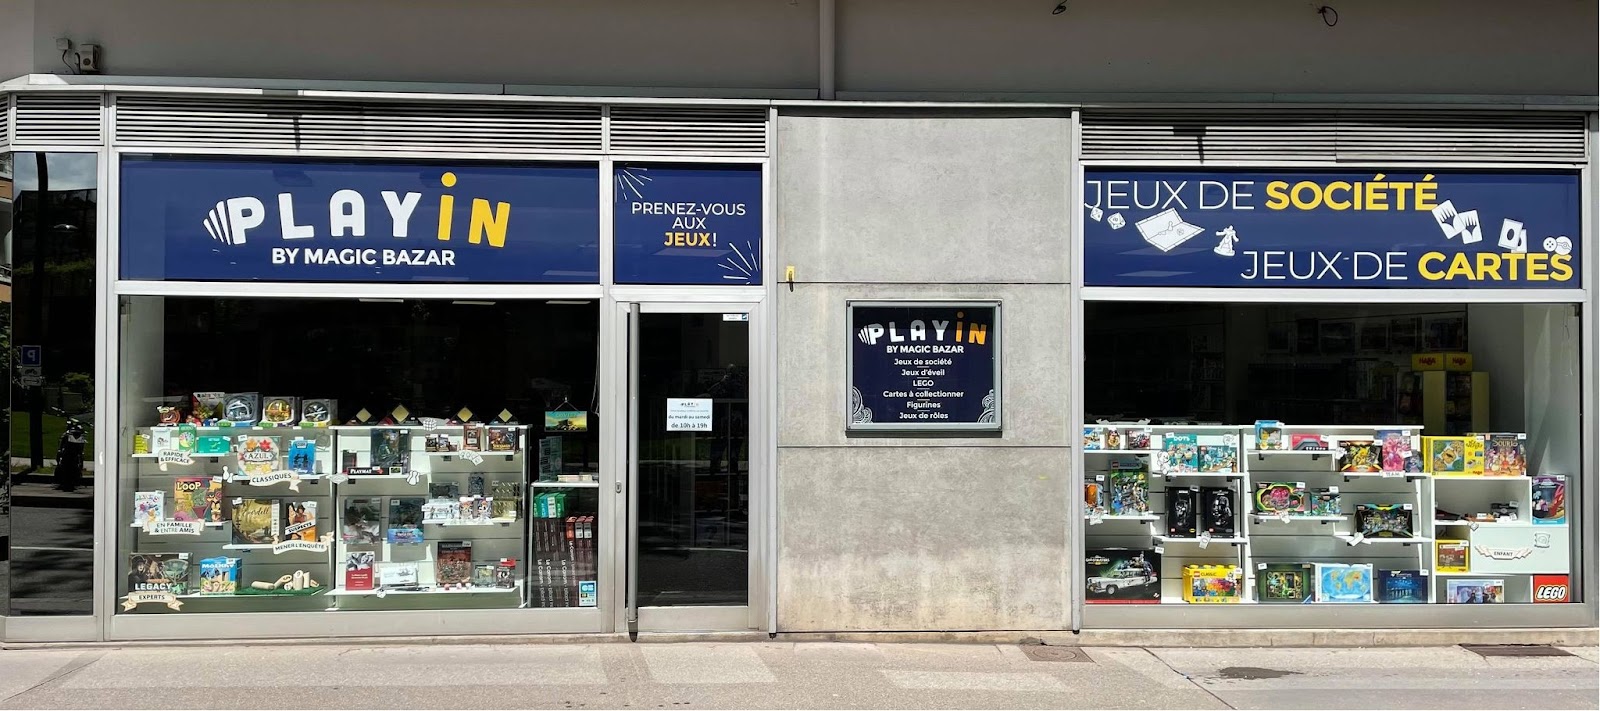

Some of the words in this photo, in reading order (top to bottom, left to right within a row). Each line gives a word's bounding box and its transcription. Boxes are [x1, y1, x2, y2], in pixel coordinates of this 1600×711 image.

[1084, 179, 1188, 211] JEUX
[1199, 181, 1255, 210] DE
[1265, 173, 1438, 212] SOCIÉTÉ
[631, 202, 747, 217] PRENEZ-VOUS
[672, 217, 706, 230] AUX
[271, 249, 296, 265] BY
[304, 248, 377, 266] MAGIC
[382, 249, 456, 266] BAZAR
[1240, 251, 1343, 281] JEUX
[1354, 252, 1408, 280] DE
[1417, 251, 1574, 282] CARTES
[886, 346, 898, 354] BY
[900, 345, 931, 354] MAGIC
[933, 345, 964, 354] BAZAR
[894, 358, 912, 366] Jeux
[913, 358, 923, 366] de
[925, 358, 953, 366] société
[901, 369, 919, 377] Jeux
[921, 369, 945, 377] d'éveil
[883, 390, 908, 398] Cartes
[909, 390, 914, 398] à
[915, 390, 965, 398] collectionner
[906, 401, 942, 410] Figurines
[899, 412, 917, 420] Jeux
[918, 412, 929, 420] de
[930, 412, 949, 420] rôles
[252, 473, 292, 483] CLASSIQUES
[1536, 586, 1566, 600] LEGO
